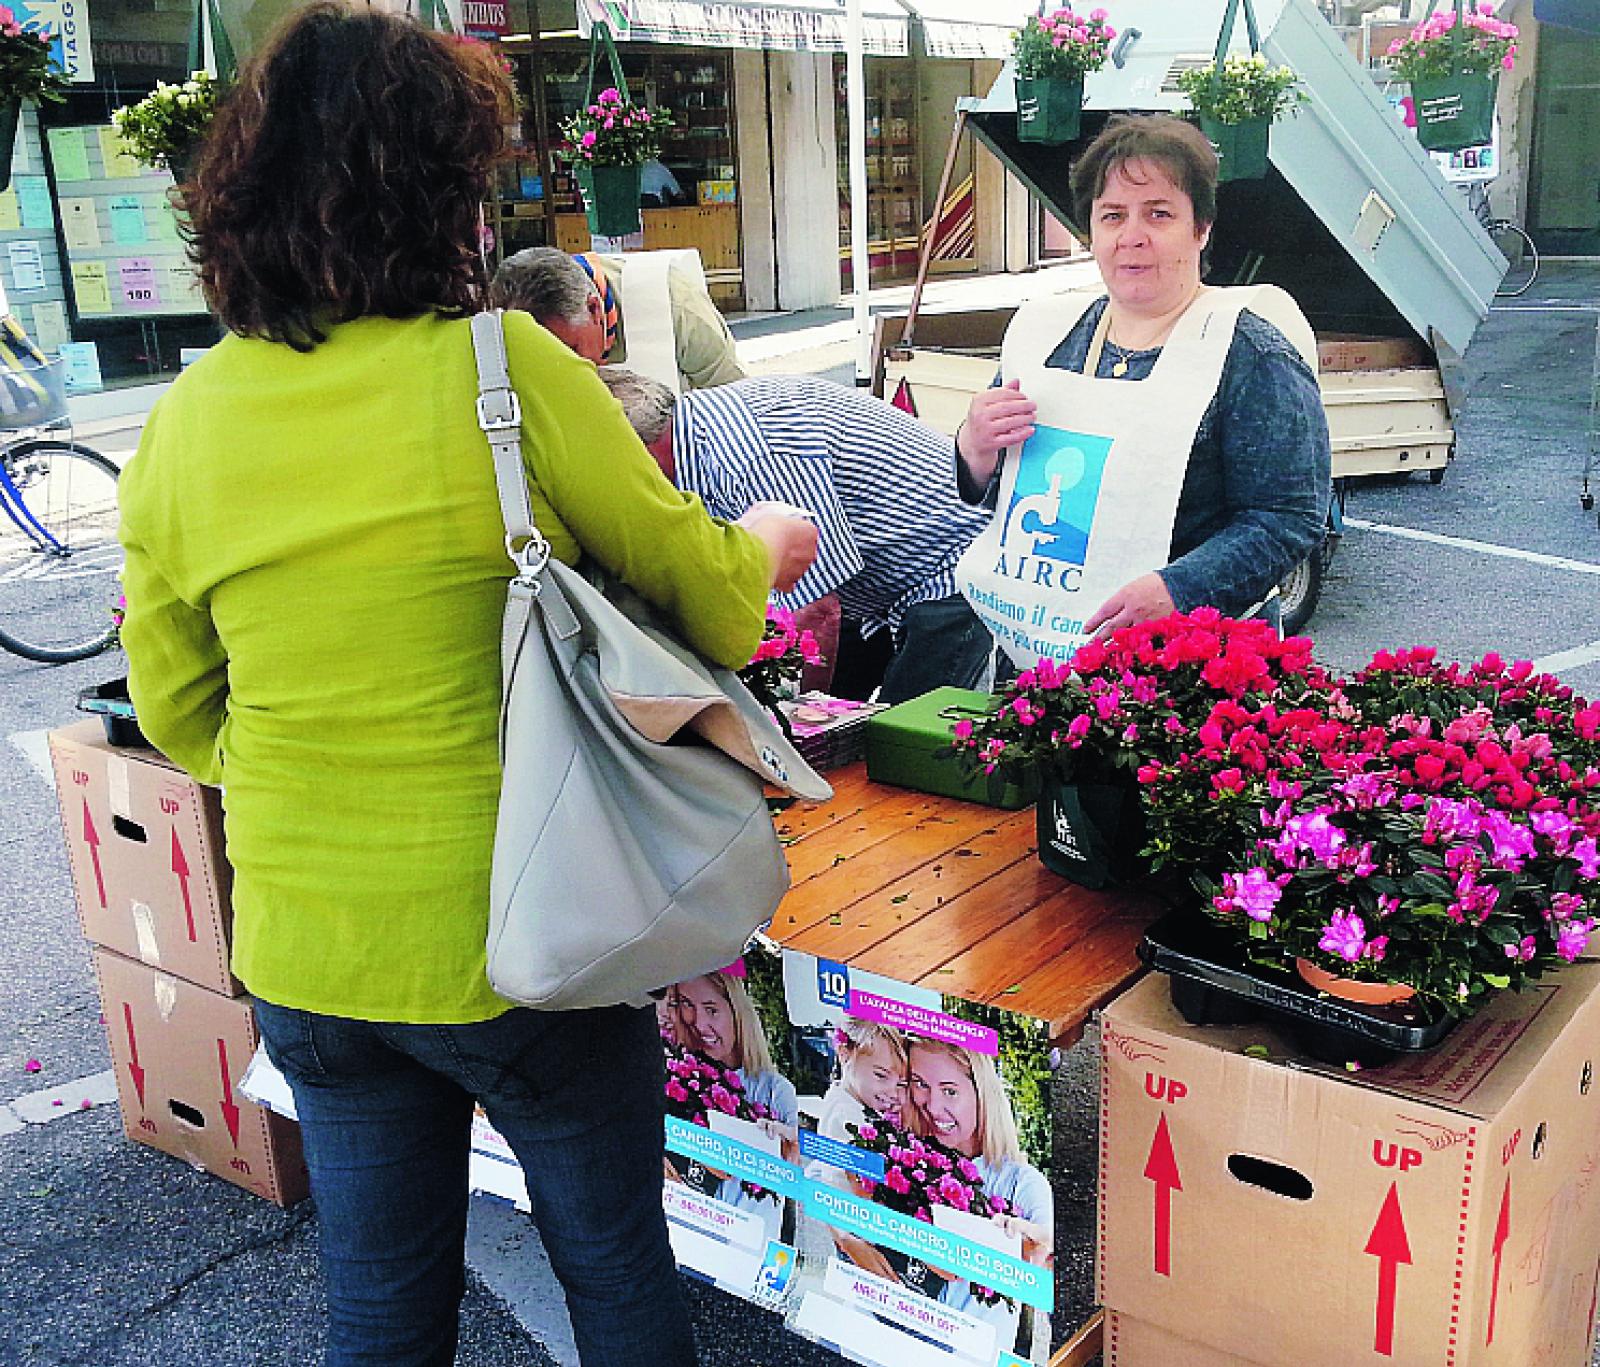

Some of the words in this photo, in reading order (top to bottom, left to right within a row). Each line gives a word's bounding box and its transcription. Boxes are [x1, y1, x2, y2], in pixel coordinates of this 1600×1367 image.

[993, 552, 1083, 592] AIRC
[1031, 604, 1046, 627] il
[72, 770, 89, 787] UP
[160, 797, 180, 815] UP
[819, 970, 846, 997] 10
[1145, 1072, 1188, 1104] UP
[1373, 1139, 1423, 1171] UP
[1502, 1128, 1521, 1167] UP
[229, 1157, 252, 1175] UP
[814, 1191, 870, 1221] CONTRO
[872, 1212, 886, 1227] IL
[956, 1245, 971, 1260] IO
[974, 1251, 990, 1266] CI
